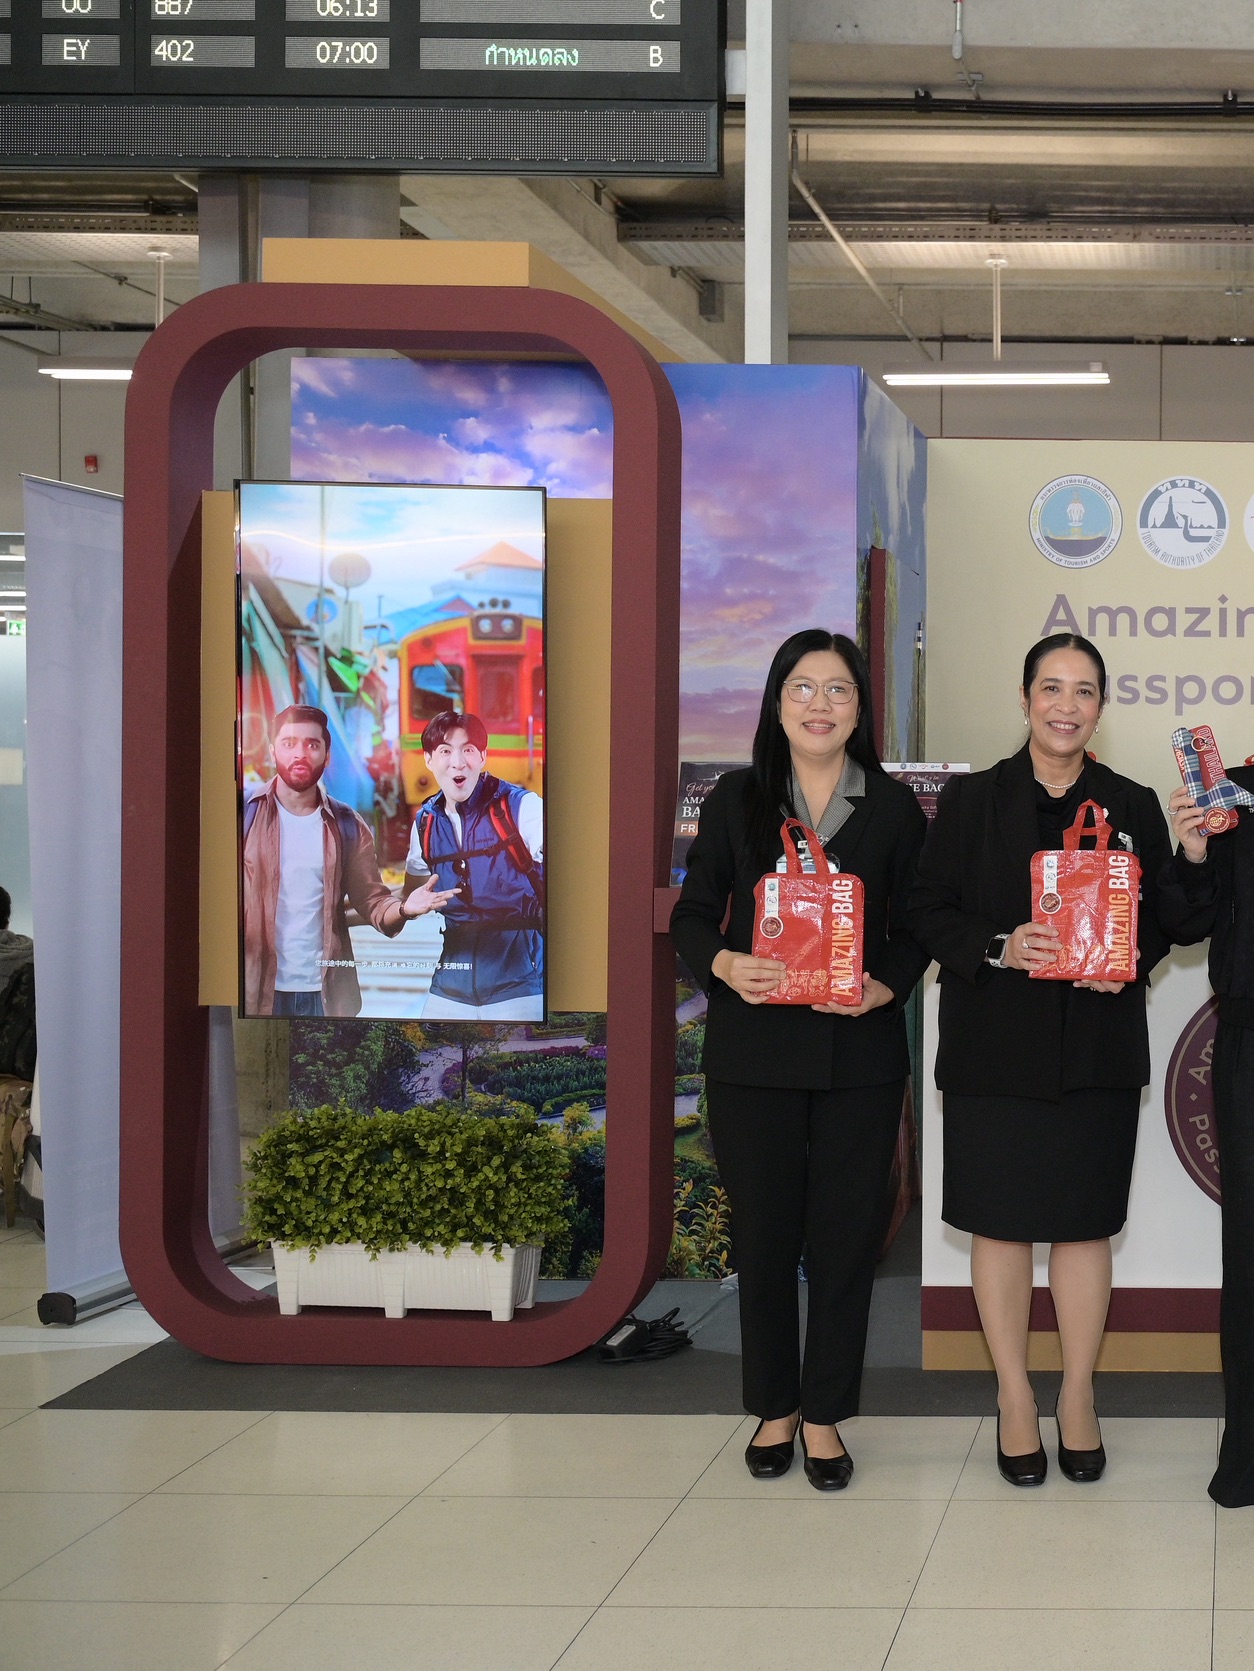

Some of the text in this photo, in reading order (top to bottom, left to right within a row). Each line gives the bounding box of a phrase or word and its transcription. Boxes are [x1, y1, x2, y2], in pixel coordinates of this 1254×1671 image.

[650, 0, 665, 20] C
[63, 39, 663, 67] EY 402 07:00 กำหนดลง B
[1036, 537, 1055, 560] MINISTRY
[1064, 559, 1088, 567] TOURISM
[1089, 554, 1101, 564] AND
[1100, 538, 1116, 557] SPORTS
[1140, 529, 1226, 567] TOURISM AUTHORITY OF THAILAND
[686, 782, 702, 796] Get
[682, 806, 701, 818] BA
[1108, 855, 1131, 972] AMAZING BAG
[830, 879, 856, 998] AMAZING BAG
